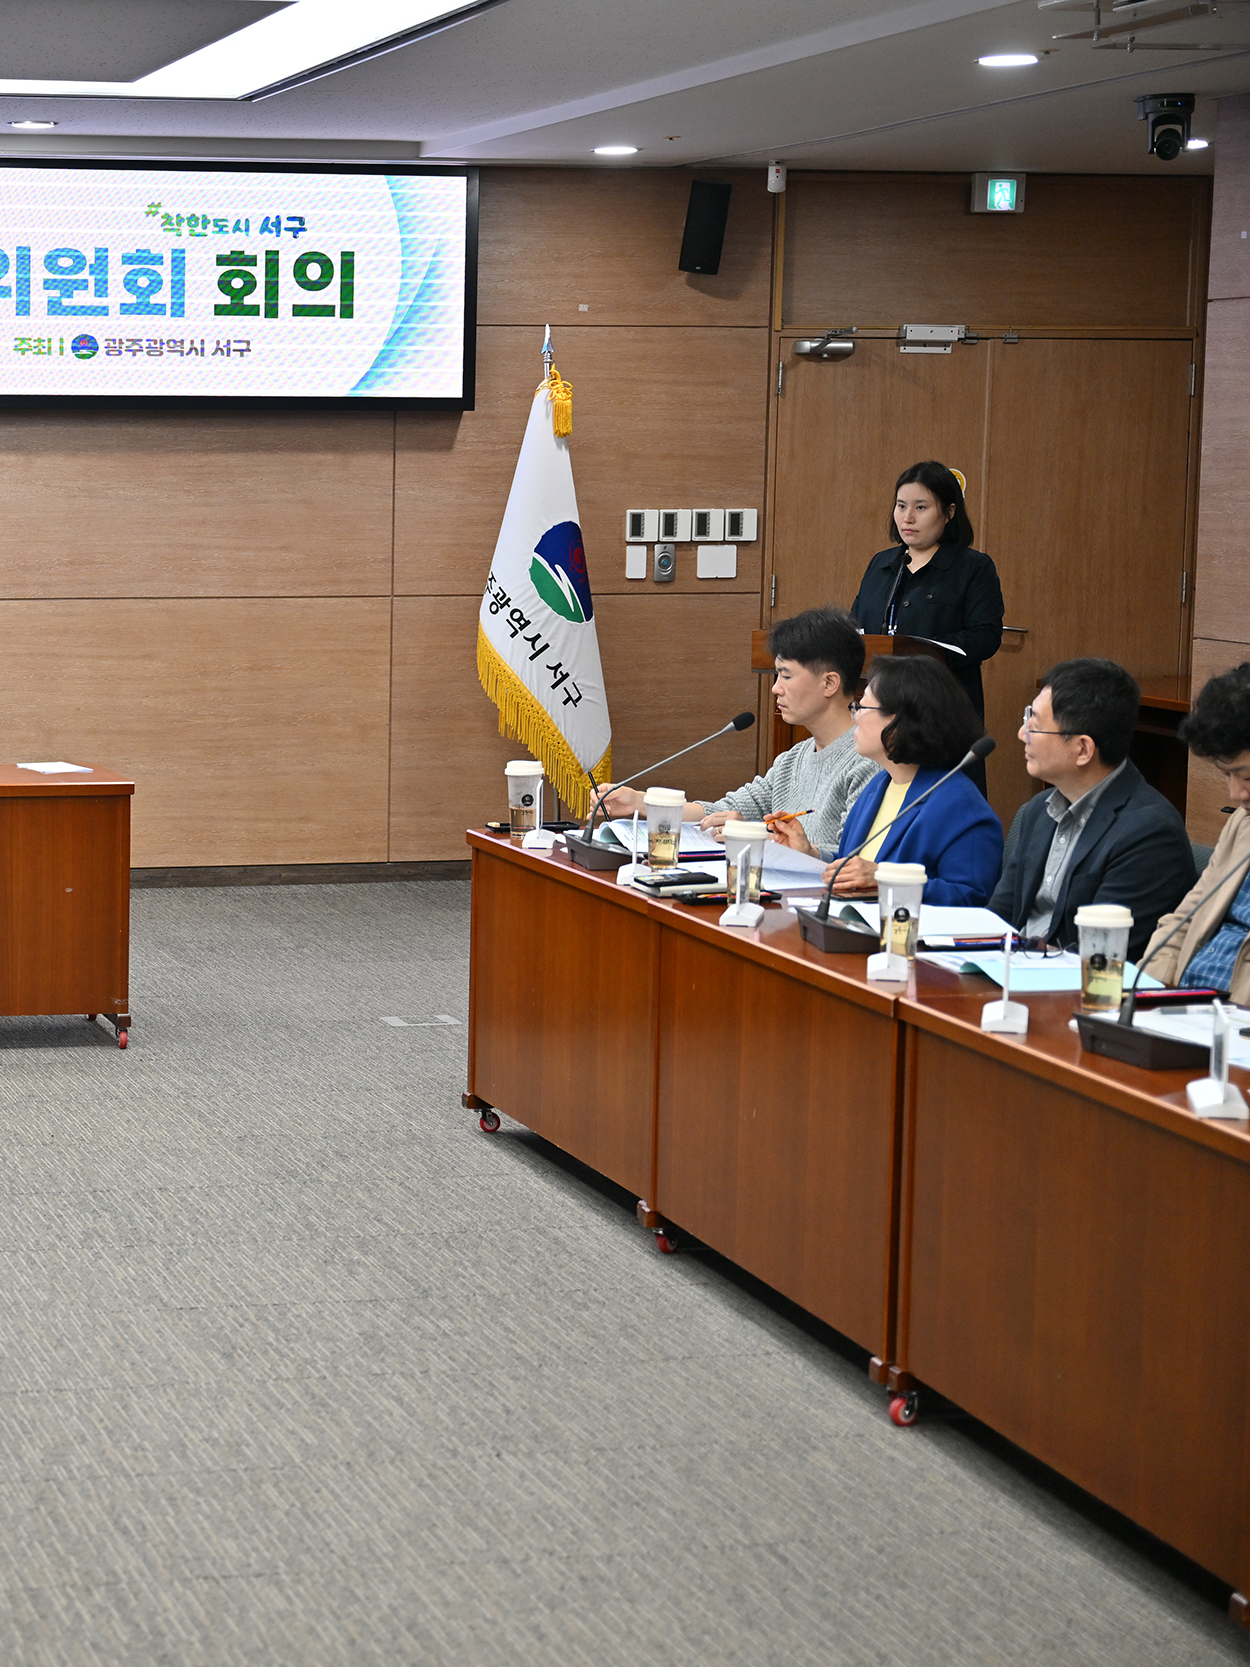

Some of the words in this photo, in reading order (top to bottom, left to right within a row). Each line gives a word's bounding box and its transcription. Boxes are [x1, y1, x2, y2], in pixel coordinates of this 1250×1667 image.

[258, 214, 308, 239] 서구
[213, 249, 356, 320] 회의
[13, 337, 53, 356] 주최
[103, 338, 205, 357] 광주광역시
[211, 339, 252, 357] 서구
[546, 662, 583, 708] 서구
